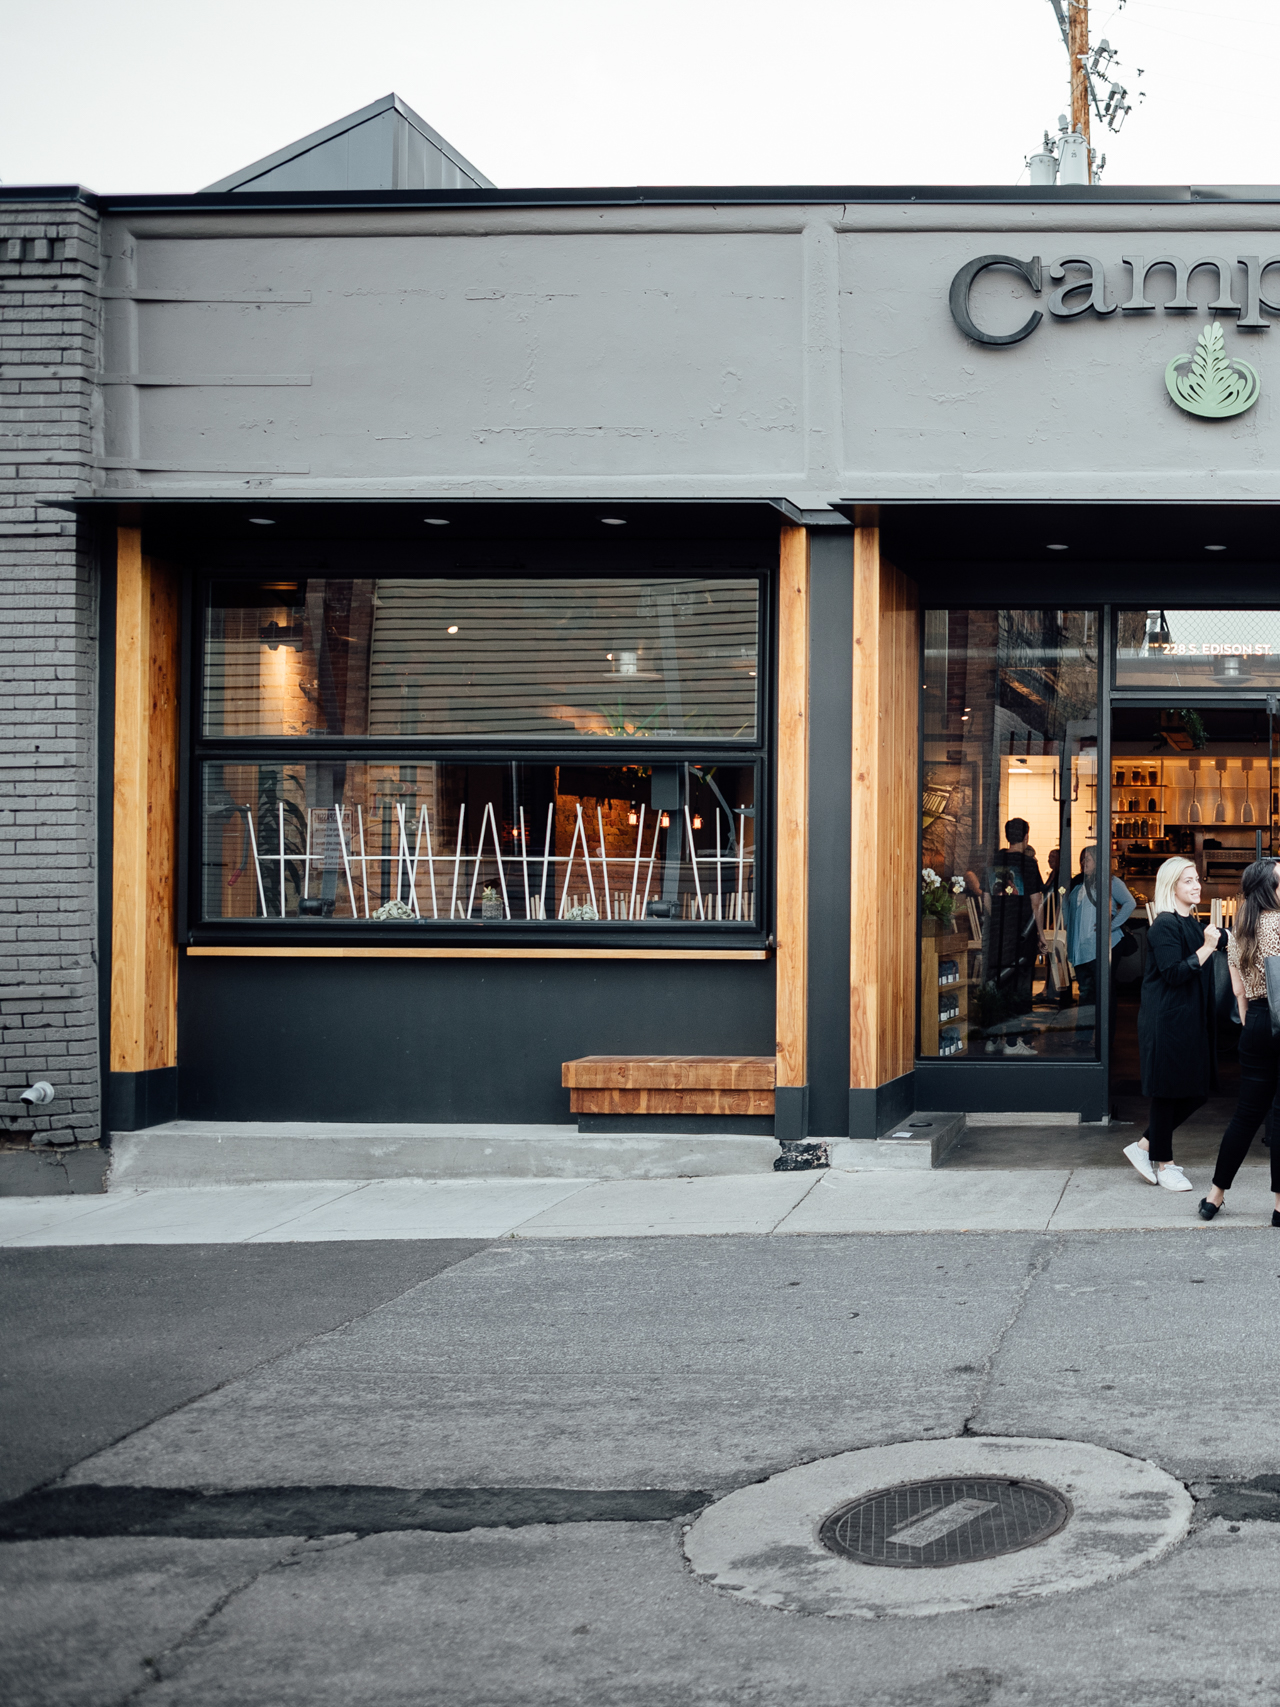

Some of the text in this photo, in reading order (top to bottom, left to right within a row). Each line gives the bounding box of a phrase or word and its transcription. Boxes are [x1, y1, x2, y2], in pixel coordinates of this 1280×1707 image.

[1163, 643, 1273, 656] 228 S. EDISON ST.
